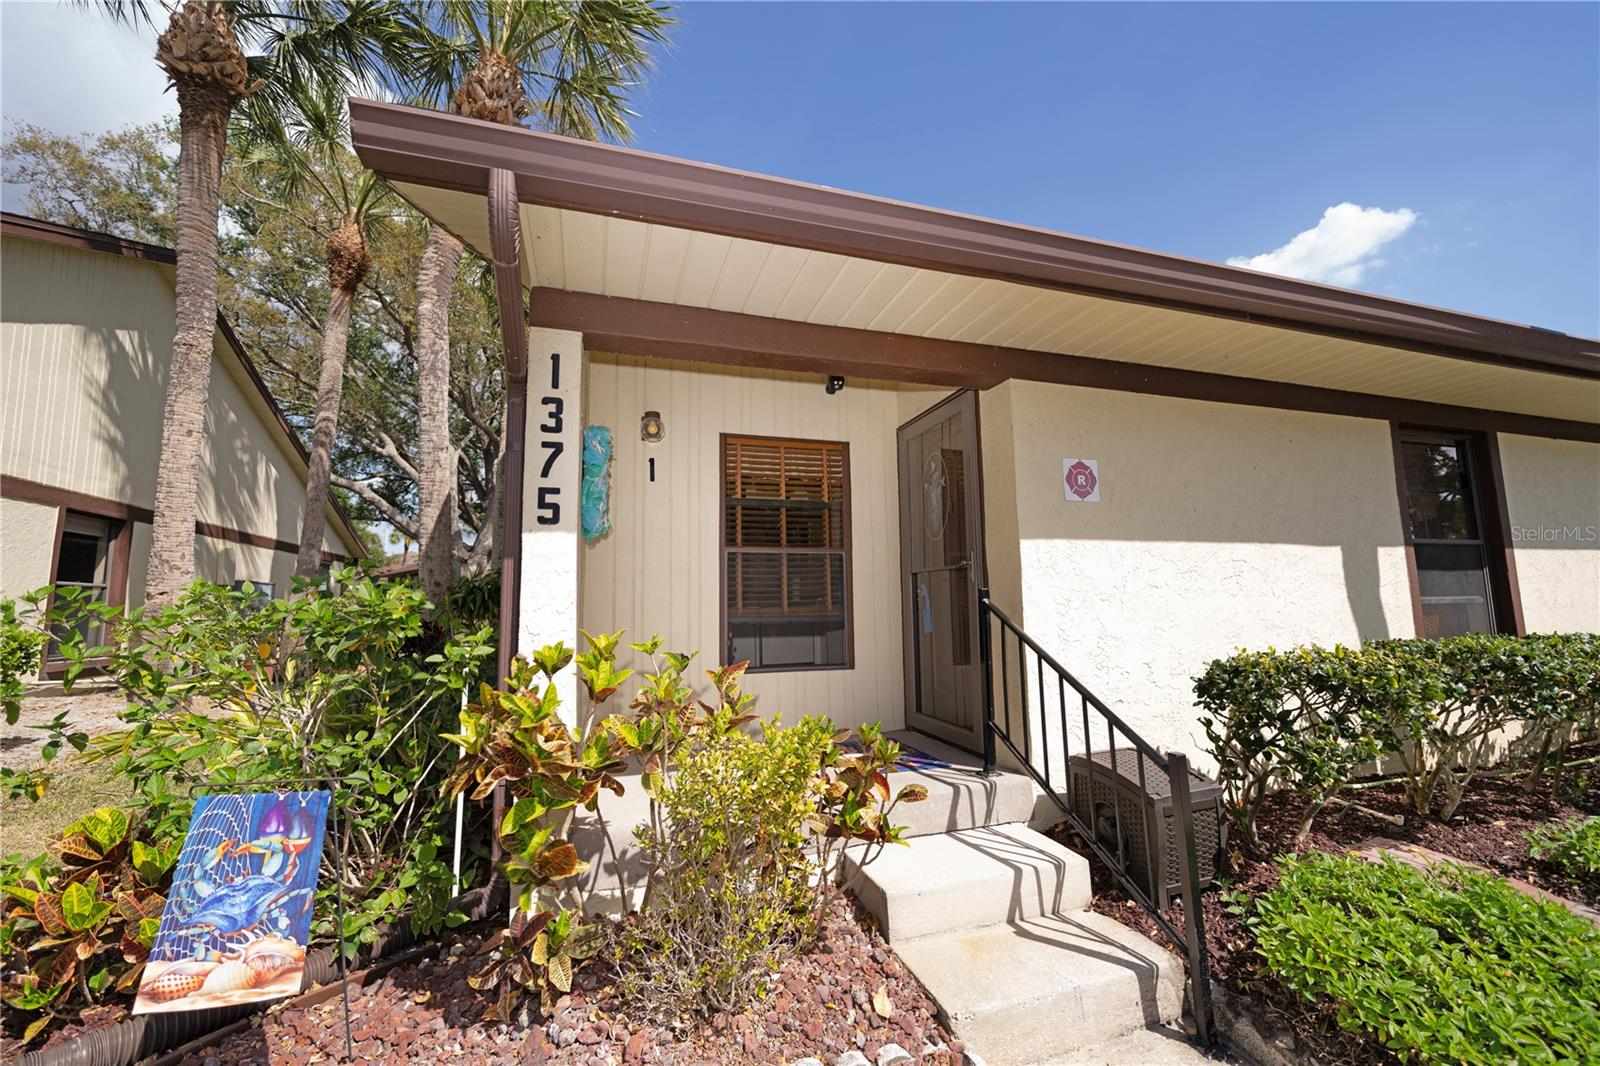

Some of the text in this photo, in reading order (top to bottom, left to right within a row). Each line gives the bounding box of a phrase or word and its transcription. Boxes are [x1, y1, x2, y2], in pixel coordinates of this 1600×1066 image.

[537, 353, 564, 525] 1375
[648, 457, 655, 482] 1
[1077, 474, 1087, 486] R
